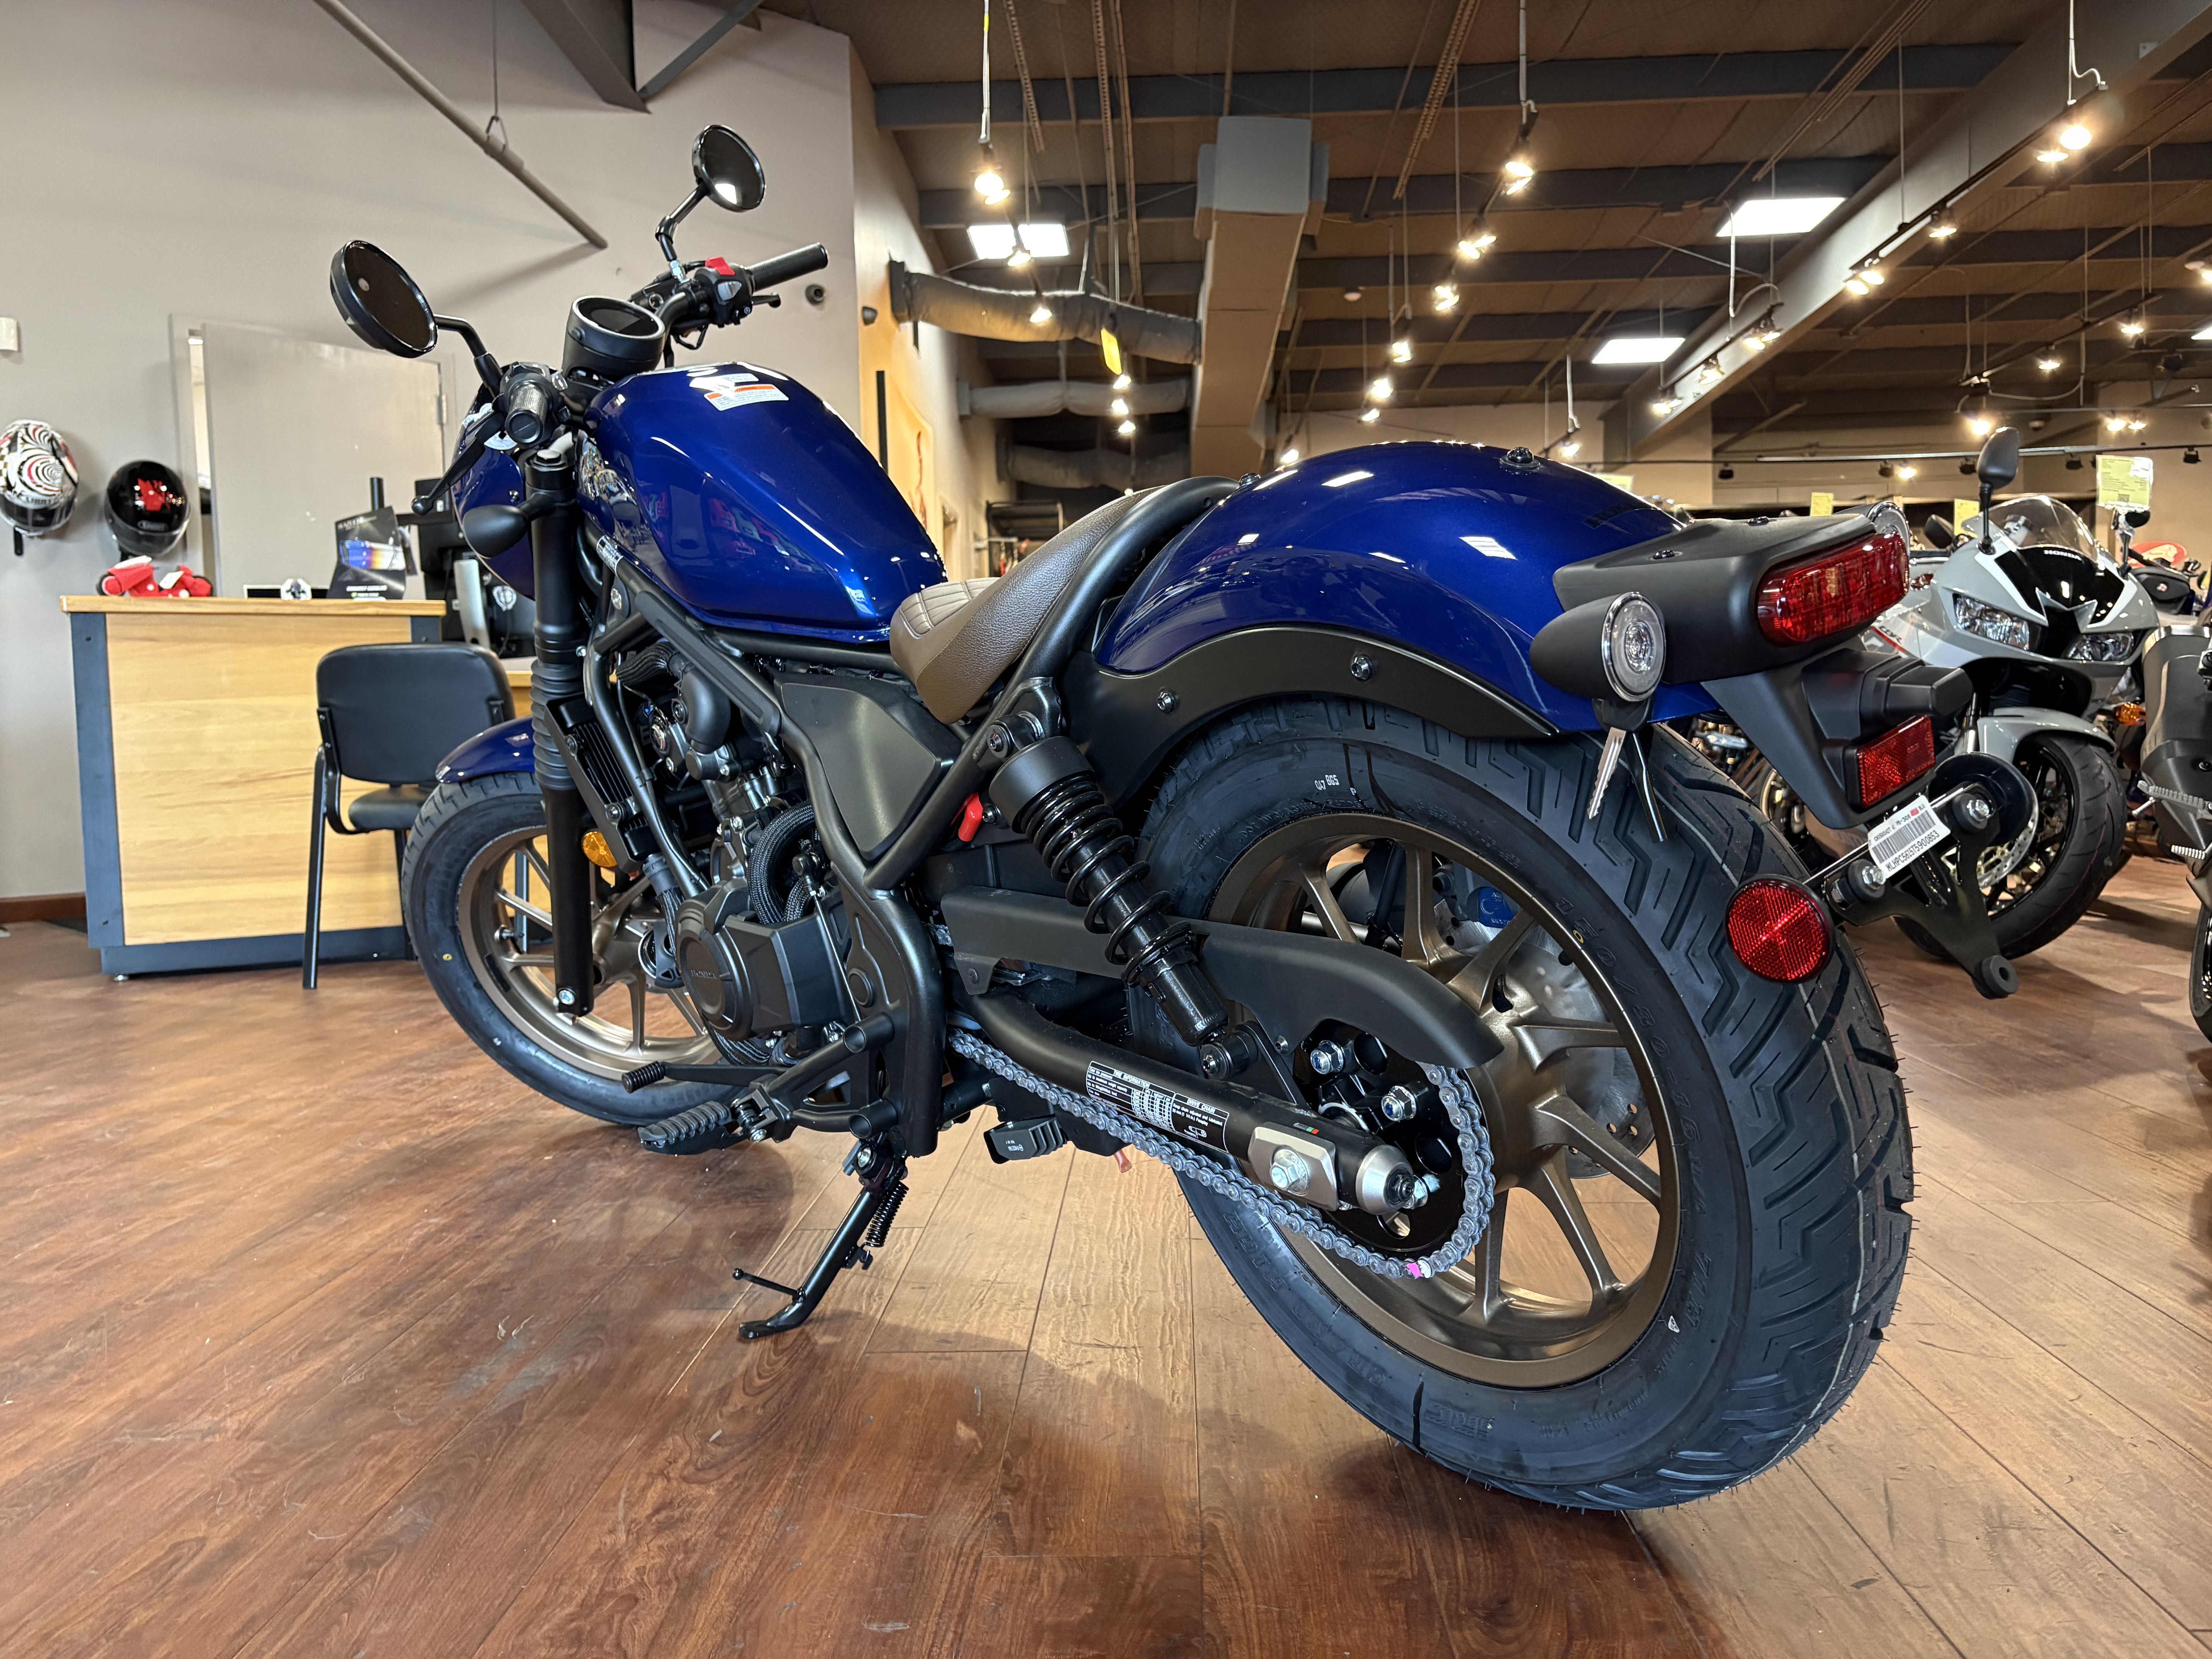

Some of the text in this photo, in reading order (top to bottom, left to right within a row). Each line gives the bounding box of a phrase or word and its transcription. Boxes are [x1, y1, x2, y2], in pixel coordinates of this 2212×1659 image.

[1123, 1074, 1151, 1089] INFORMATION
[1187, 1099, 1216, 1114] DRIVE CHAIN
